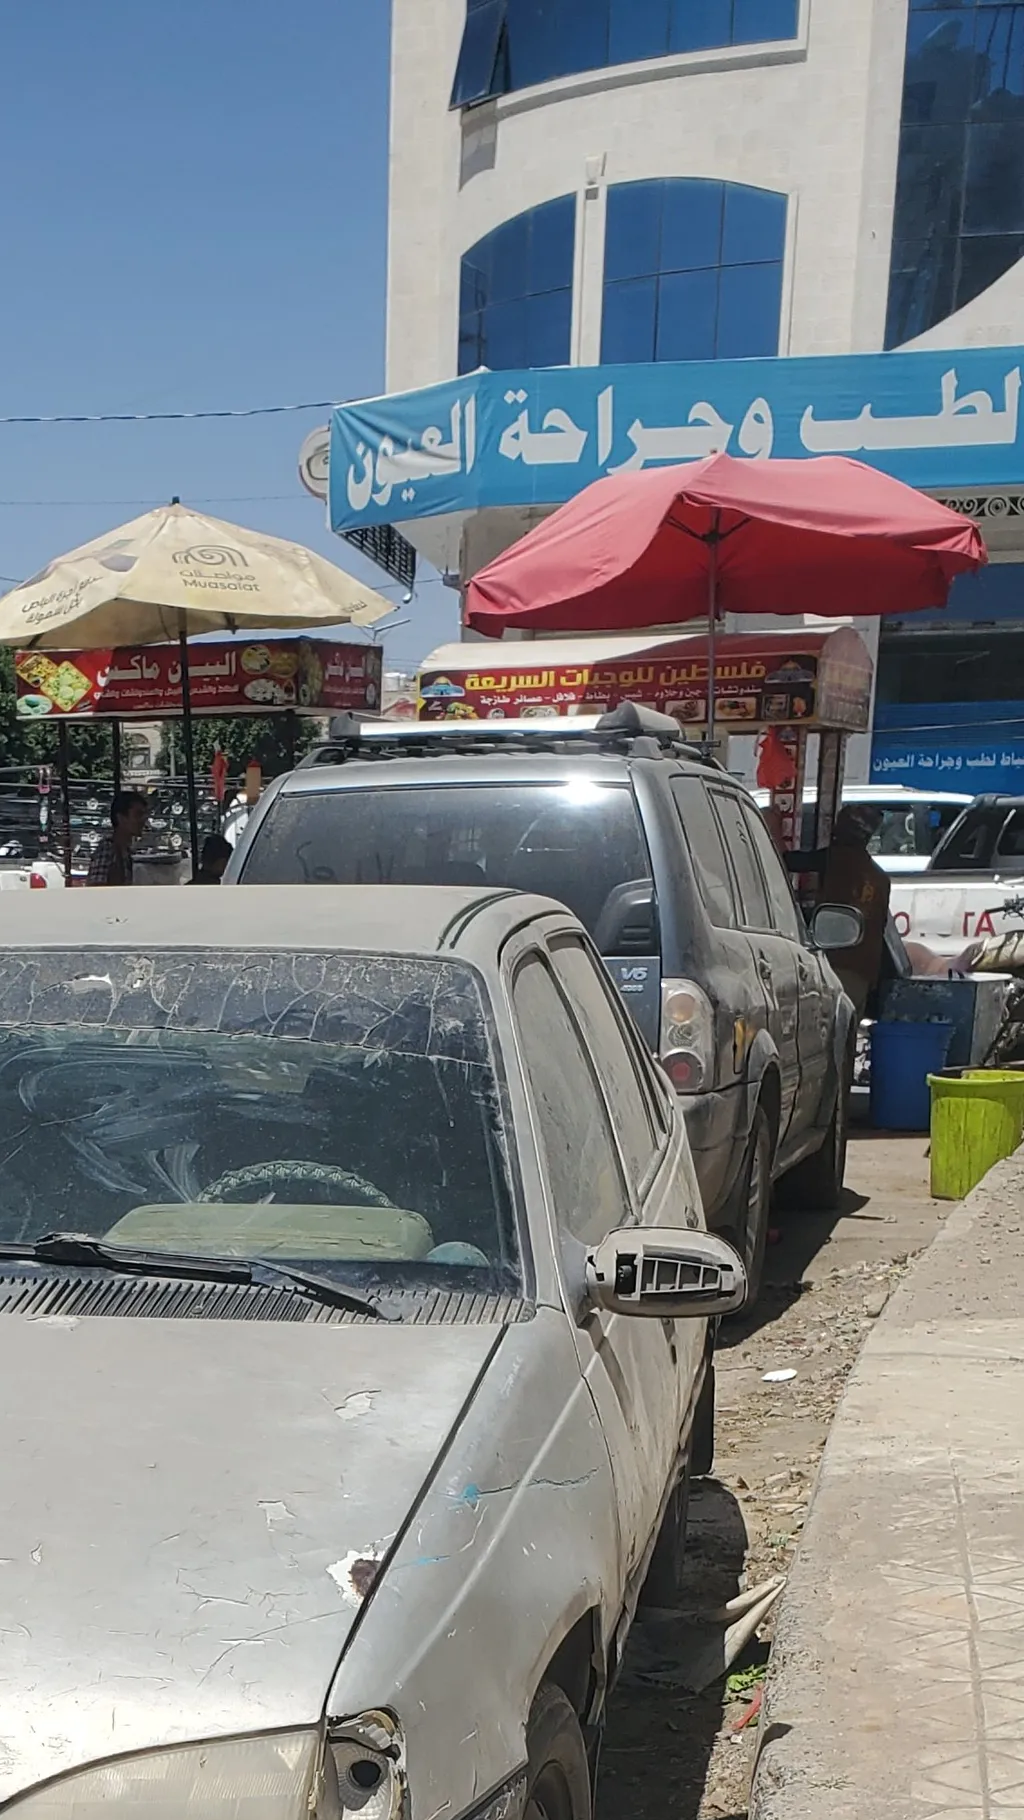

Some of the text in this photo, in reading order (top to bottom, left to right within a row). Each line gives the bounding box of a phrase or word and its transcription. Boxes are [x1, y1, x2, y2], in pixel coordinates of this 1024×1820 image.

[347, 393, 476, 511] العيون
[465, 661, 767, 691] فلسطين للوجبات السريعة
[873, 754, 915, 772] العيون
[918, 752, 963, 770] وجراحة
[966, 752, 996, 768] لطب
[620, 967, 648, 981] V6
